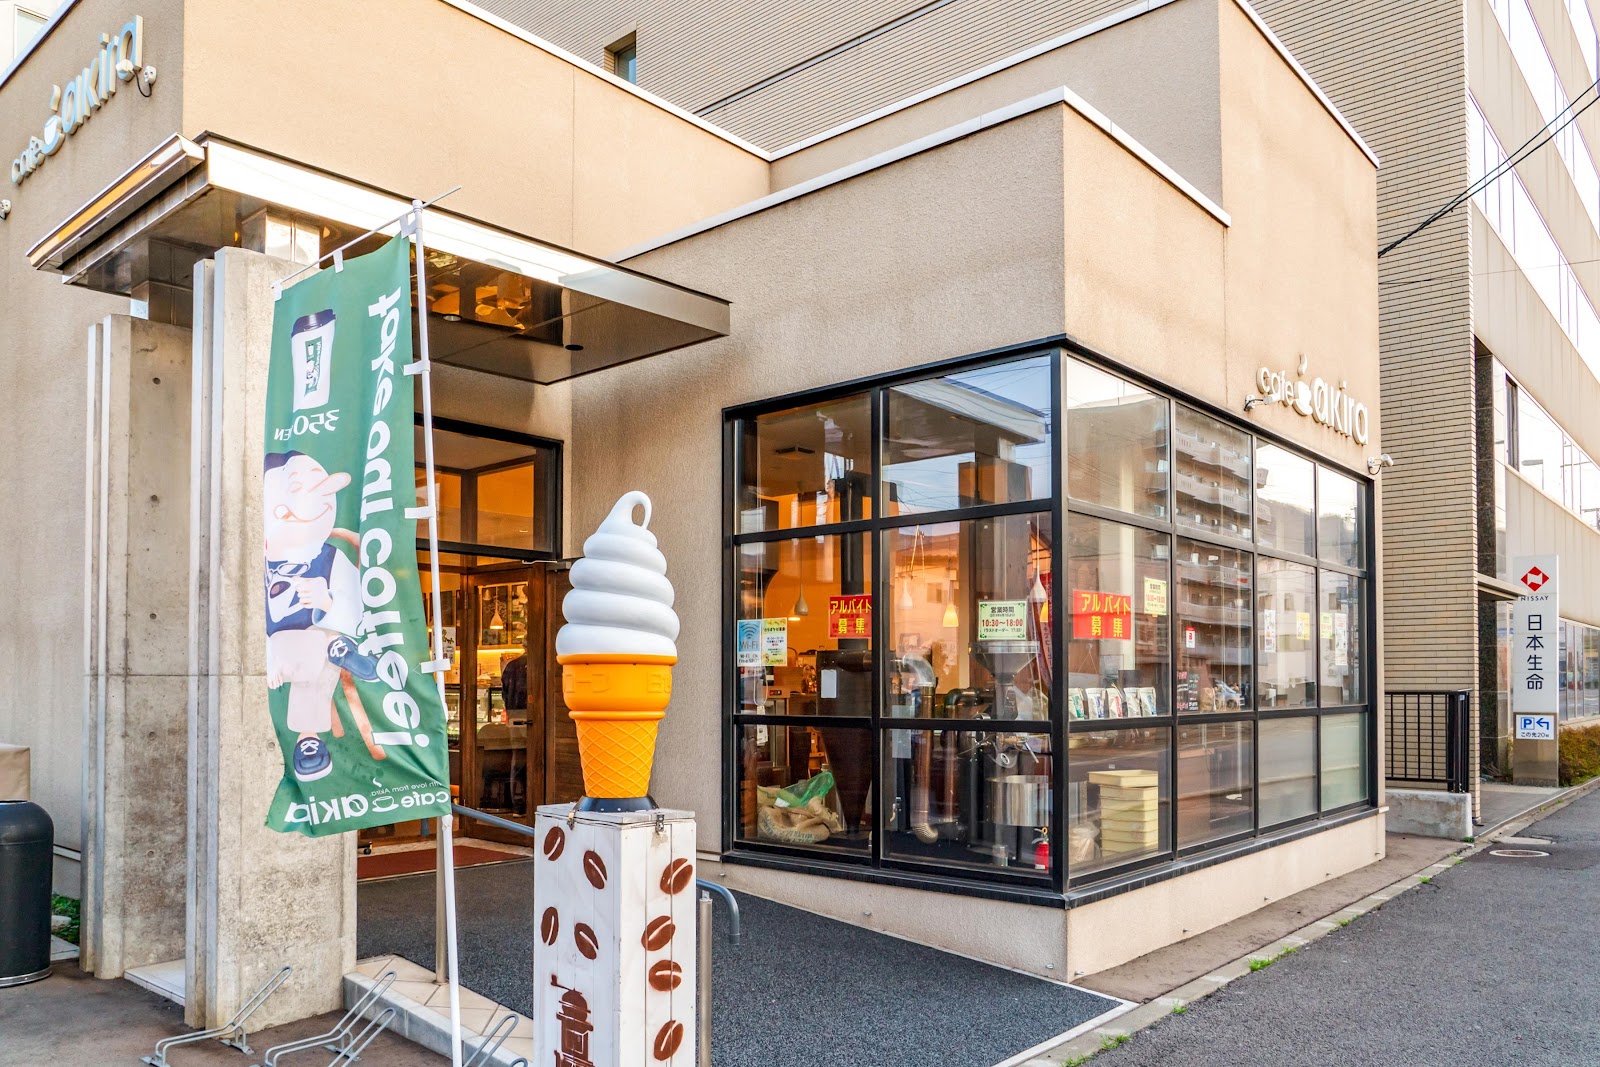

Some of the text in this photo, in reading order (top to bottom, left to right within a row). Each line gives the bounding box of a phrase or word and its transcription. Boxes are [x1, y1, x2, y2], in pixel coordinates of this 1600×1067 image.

[61, 15, 143, 135] akira
[1256, 367, 1369, 446] cafe akira
[830, 598, 872, 615] アルバイト
[1081, 593, 1131, 616] アルバイト
[838, 618, 865, 634] 募集
[1091, 615, 1123, 637] 募集
[1526, 614, 1544, 690] 日本生命
[1523, 718, 1533, 728] P
